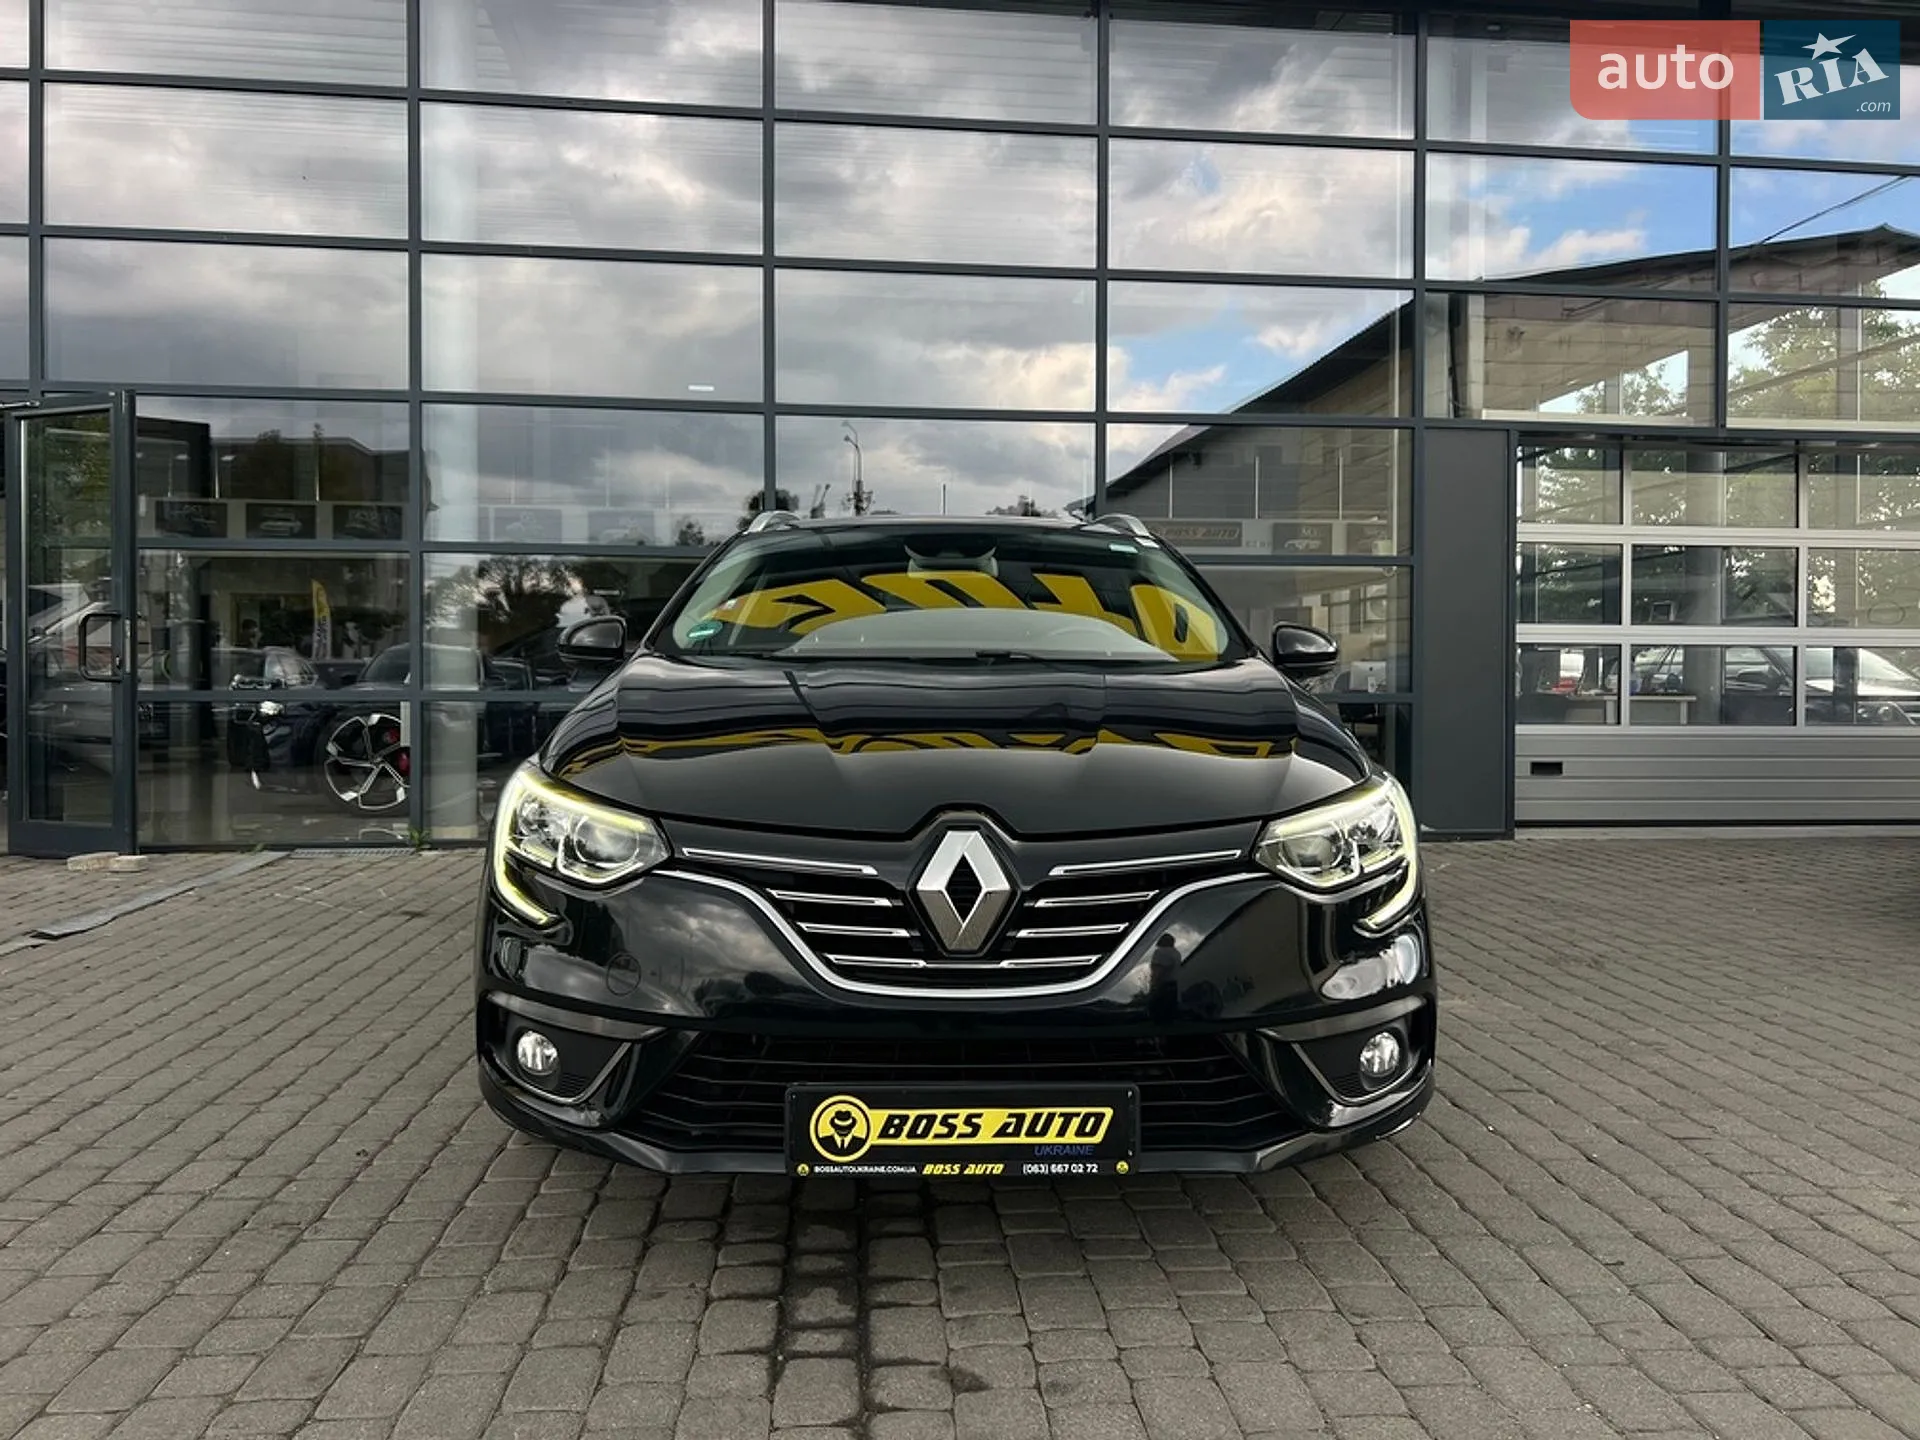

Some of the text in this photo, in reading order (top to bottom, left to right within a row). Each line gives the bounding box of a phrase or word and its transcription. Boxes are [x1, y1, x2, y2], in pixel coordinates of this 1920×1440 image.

[877, 1112, 1107, 1139] BOSS AUTO
[1034, 1145, 1094, 1156] UKRAINE
[922, 1163, 1004, 1175] BOSS AUTO
[1070, 1163, 1084, 1173] 02
[1086, 1163, 1098, 1173] 72
